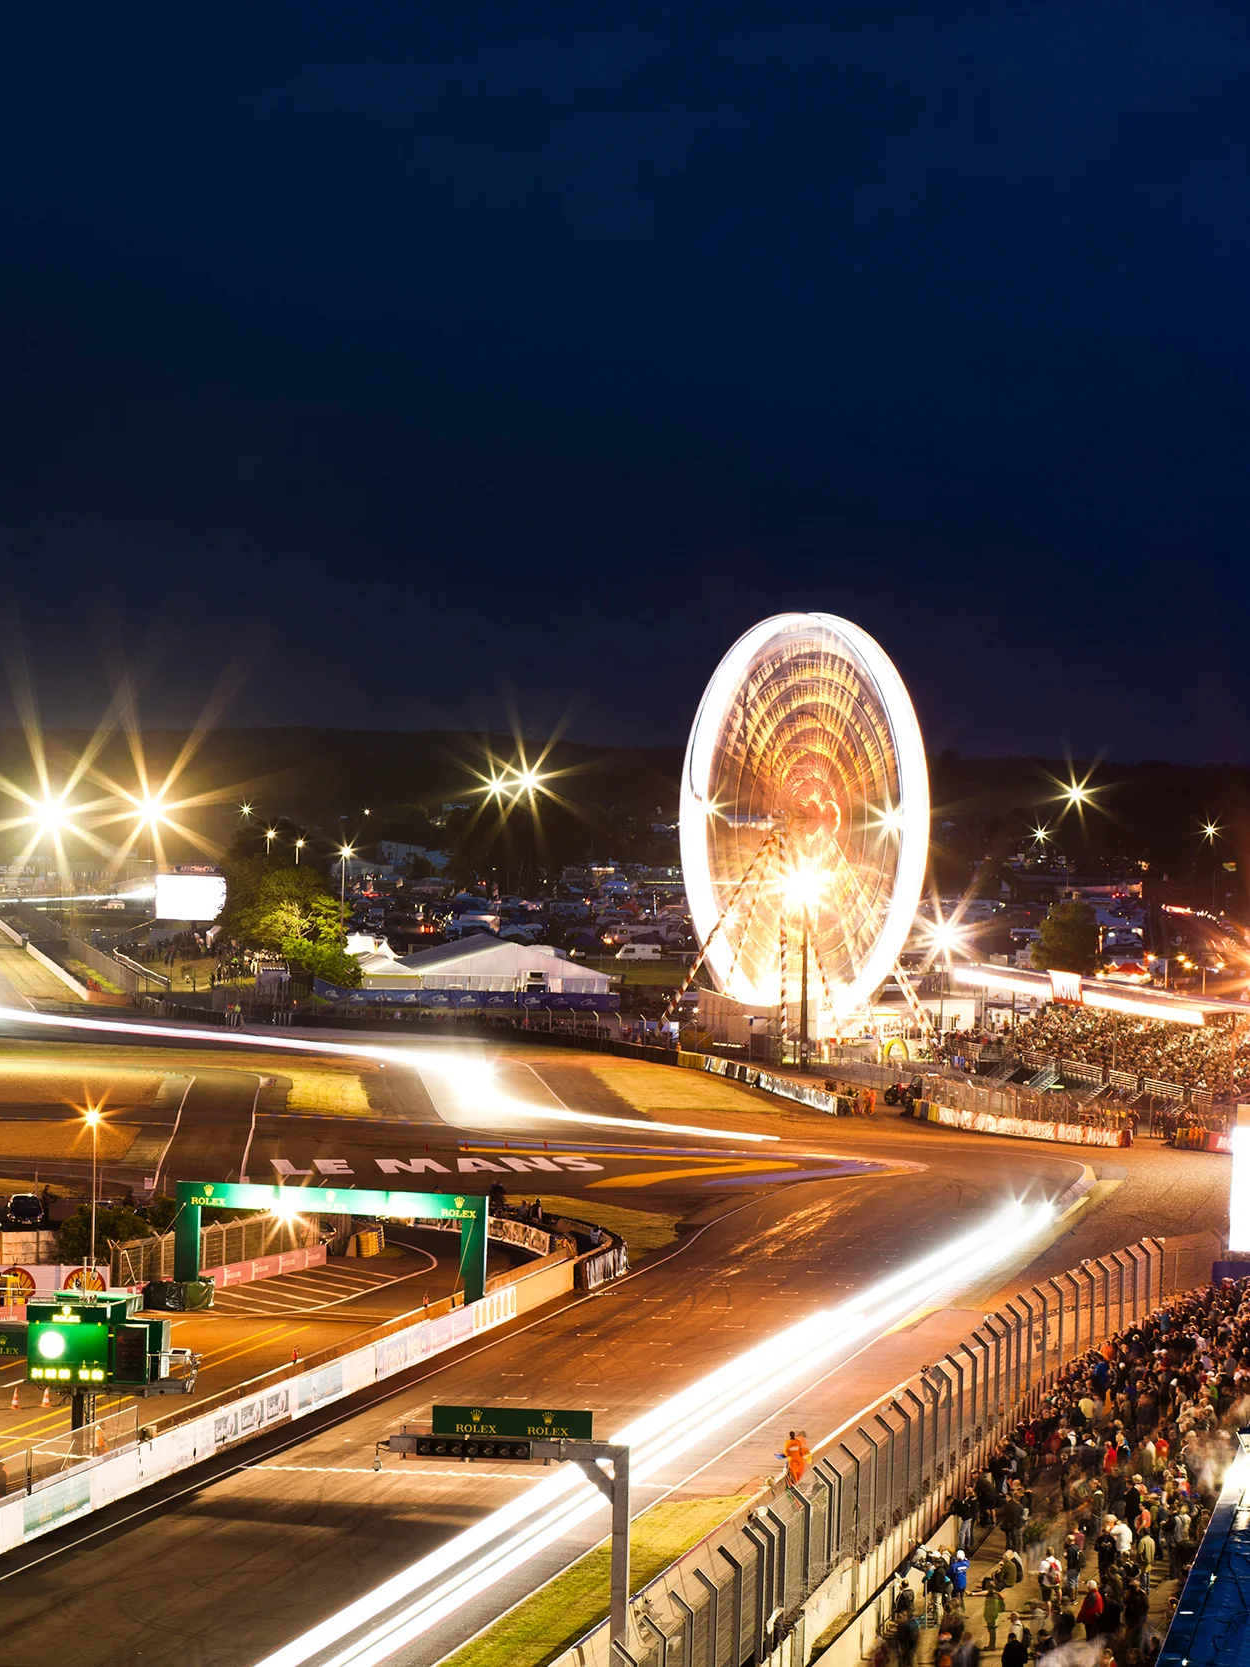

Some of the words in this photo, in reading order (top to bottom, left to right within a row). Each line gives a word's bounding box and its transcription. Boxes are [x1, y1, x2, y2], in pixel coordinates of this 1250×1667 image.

[270, 1158, 354, 1175] LE
[375, 1156, 605, 1173] MANS
[191, 1196, 226, 1206] ROLEX
[441, 1208, 477, 1219] ROLEX
[455, 1424, 497, 1434] ROLEX
[527, 1426, 569, 1437] ROLEX
